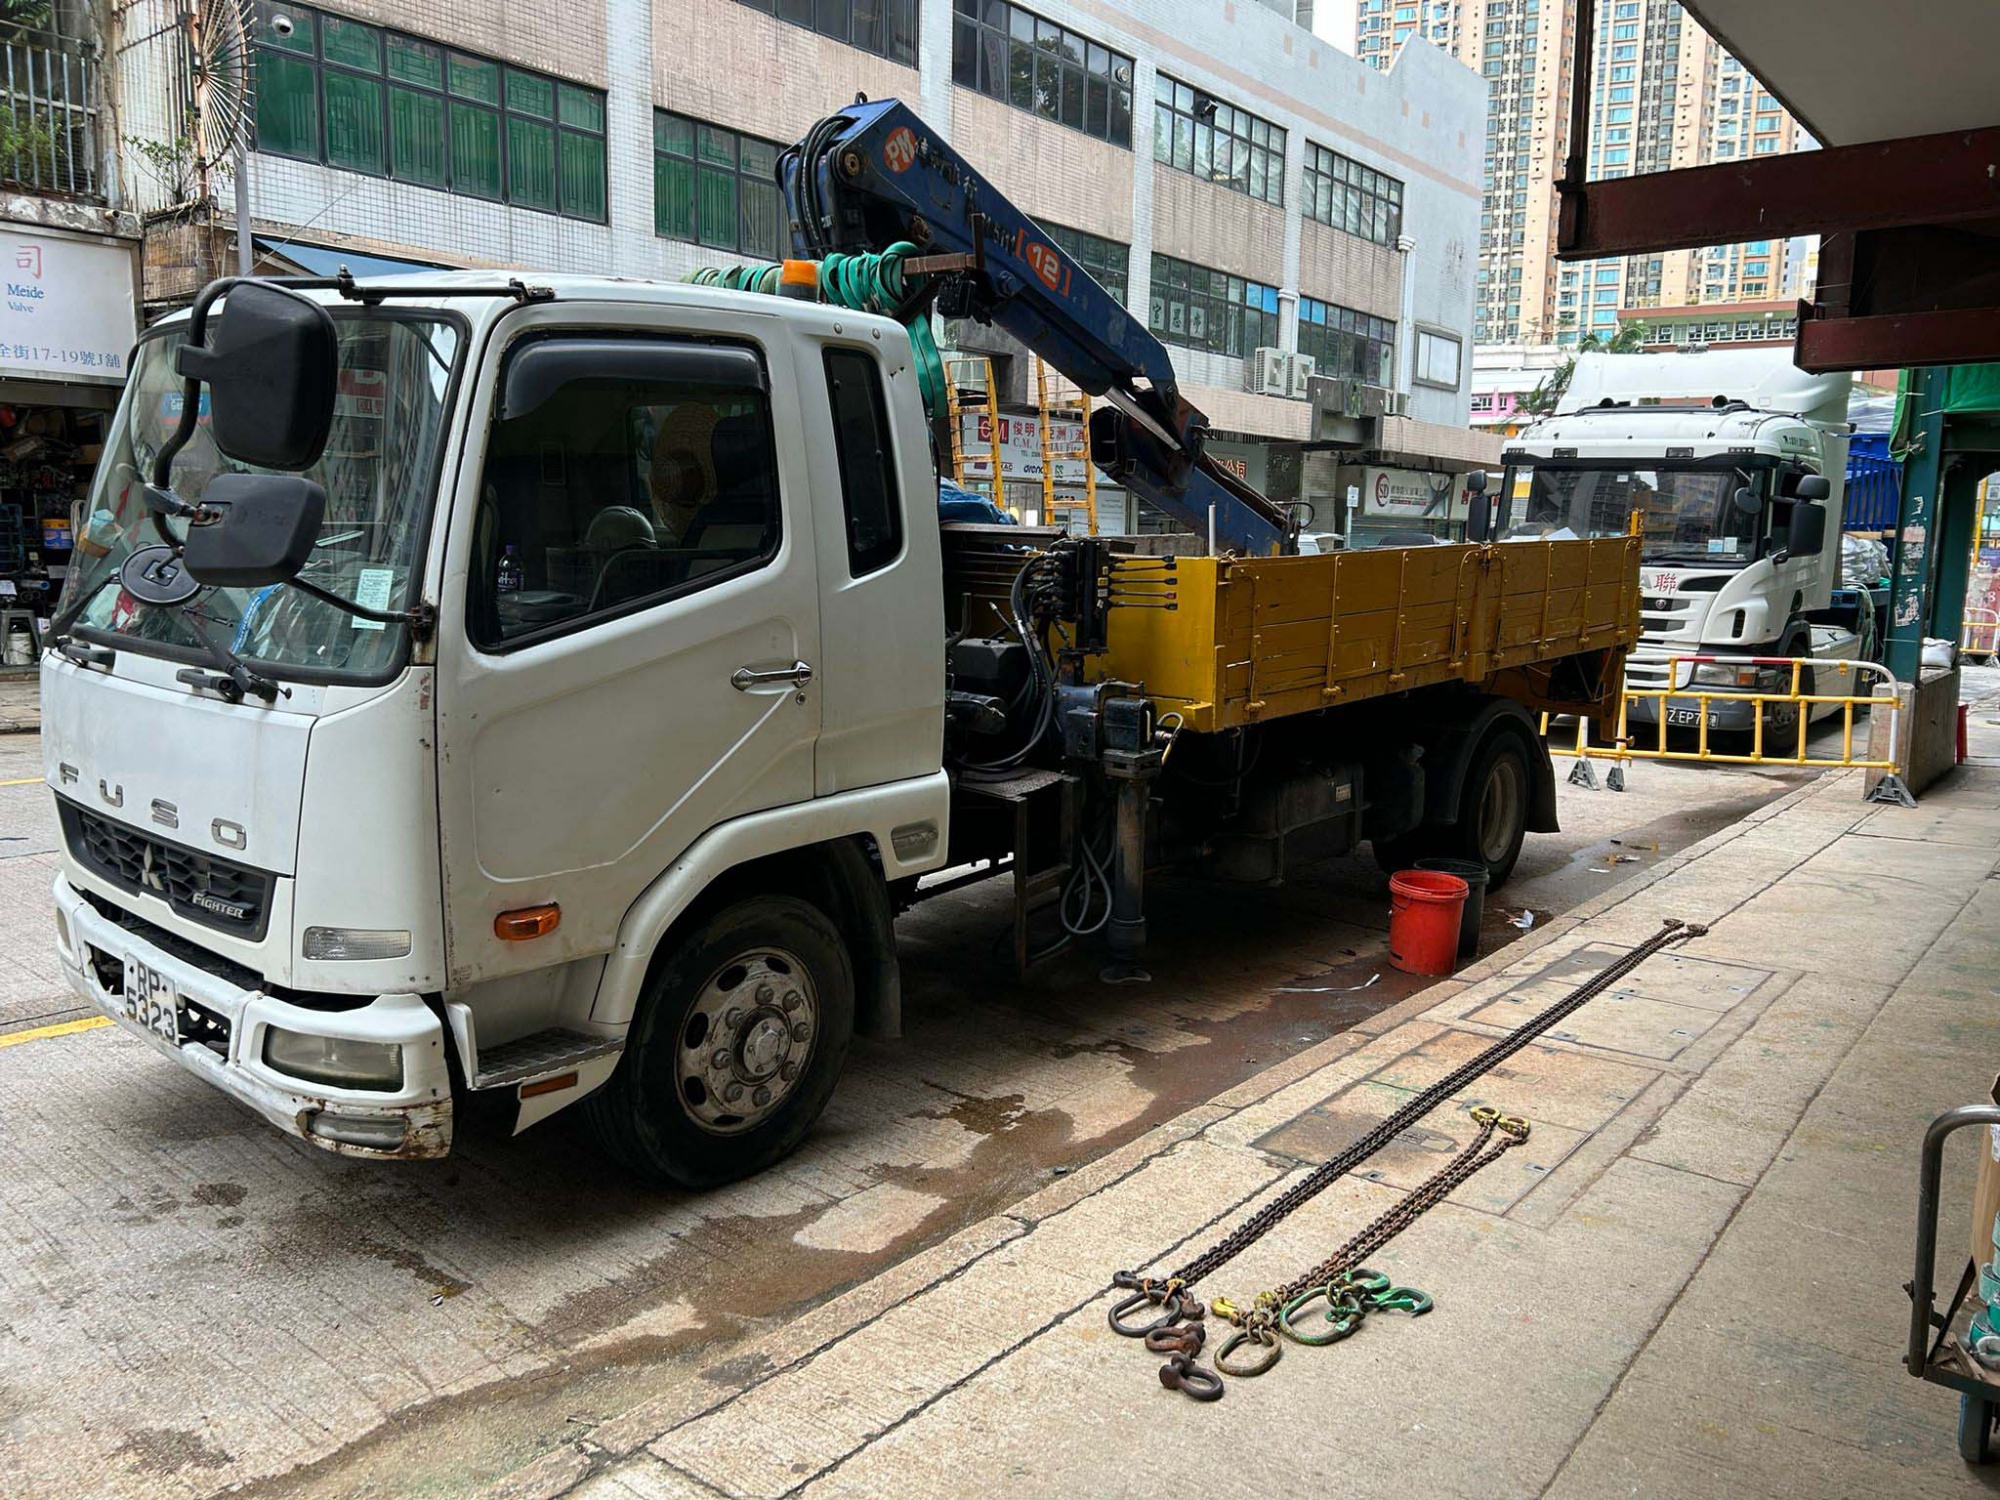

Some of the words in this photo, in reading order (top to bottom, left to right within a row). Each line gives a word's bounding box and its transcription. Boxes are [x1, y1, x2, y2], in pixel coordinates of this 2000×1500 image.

[884, 128, 914, 172] PM
[15, 245, 42, 279] 司
[7, 283, 44, 299] Meide
[7, 301, 34, 313] Valve
[1653, 573, 1677, 594] 聯
[59, 762, 247, 851] FUSO
[192, 892, 244, 919] FIGHTER
[138, 964, 160, 999] RP
[126, 986, 175, 1041] 5323
